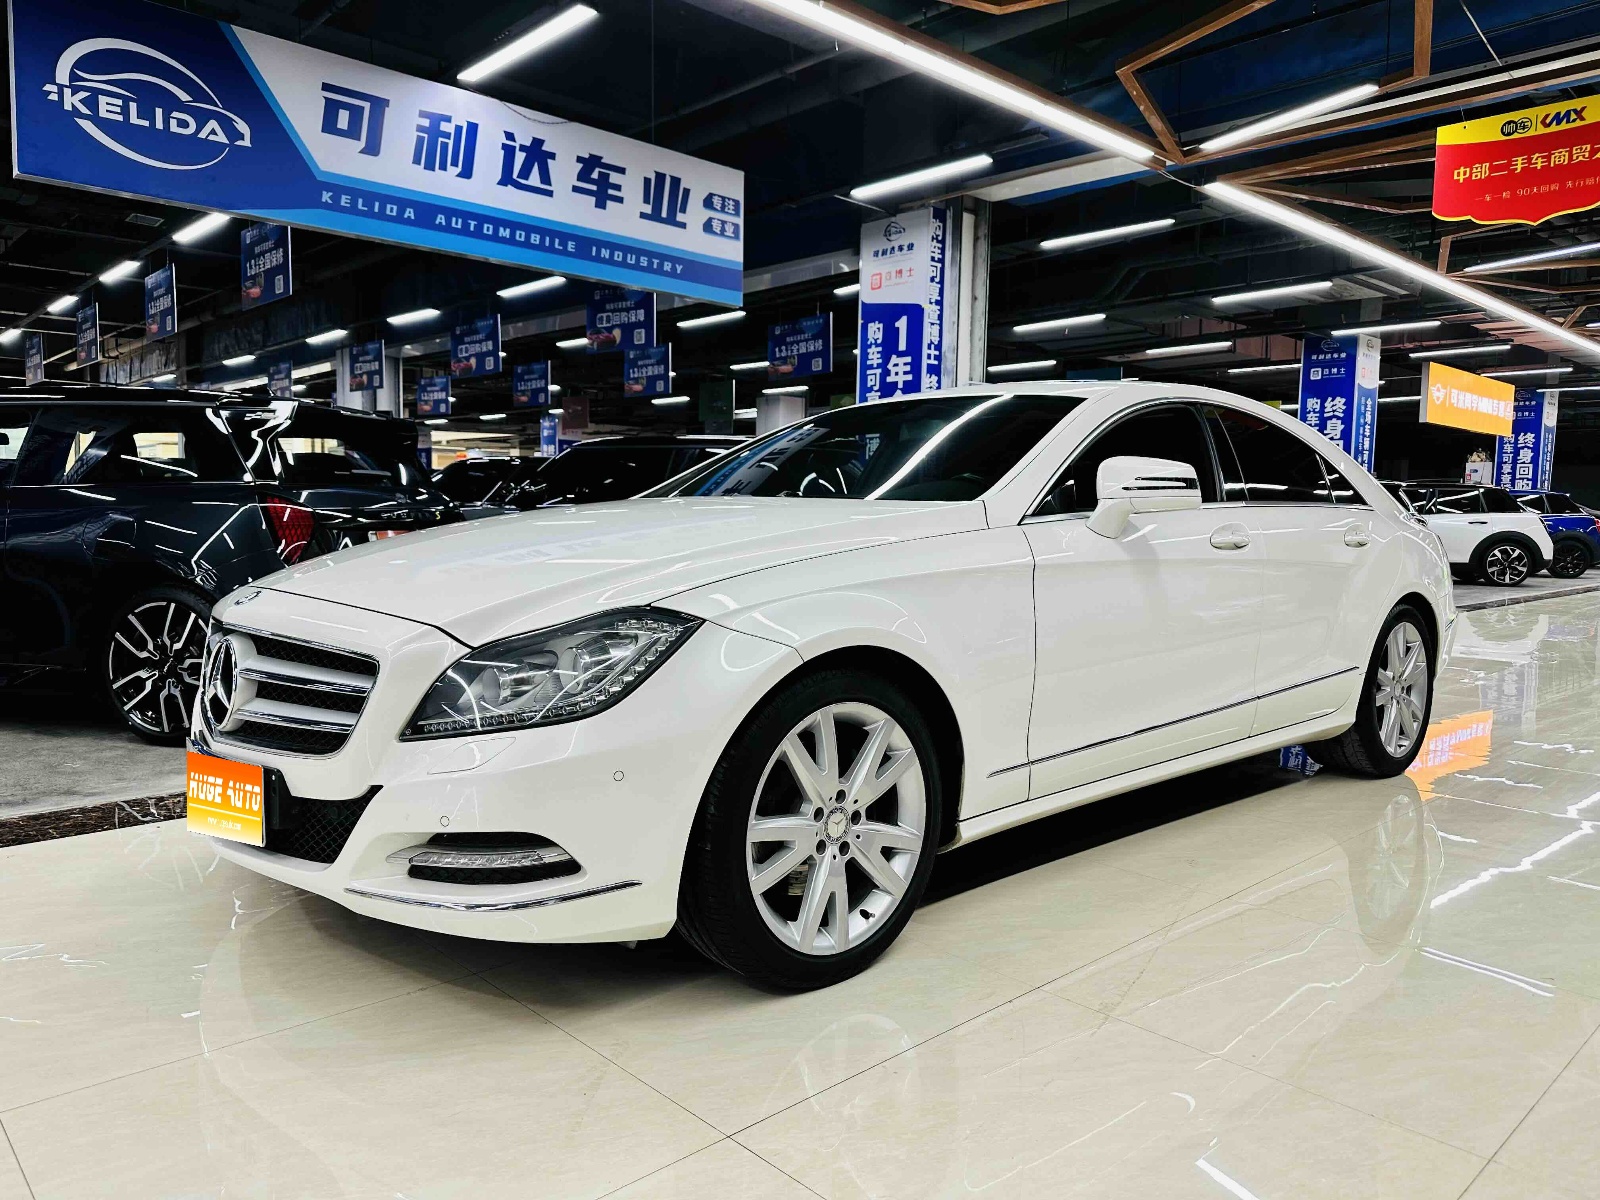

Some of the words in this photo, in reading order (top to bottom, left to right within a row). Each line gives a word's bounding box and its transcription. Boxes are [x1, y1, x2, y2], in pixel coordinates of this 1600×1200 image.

[63, 87, 229, 145] KELIDA
[321, 82, 690, 229] 可利达车业
[712, 195, 736, 214] 专注
[1517, 184, 1559, 198] 90天回购
[321, 190, 416, 221] KELIDA
[435, 213, 578, 252] AUTOMOBILE
[591, 245, 686, 275] INDUSTRY
[711, 218, 735, 237] 专业
[886, 315, 913, 398] 1年
[1305, 397, 1321, 432] 购车
